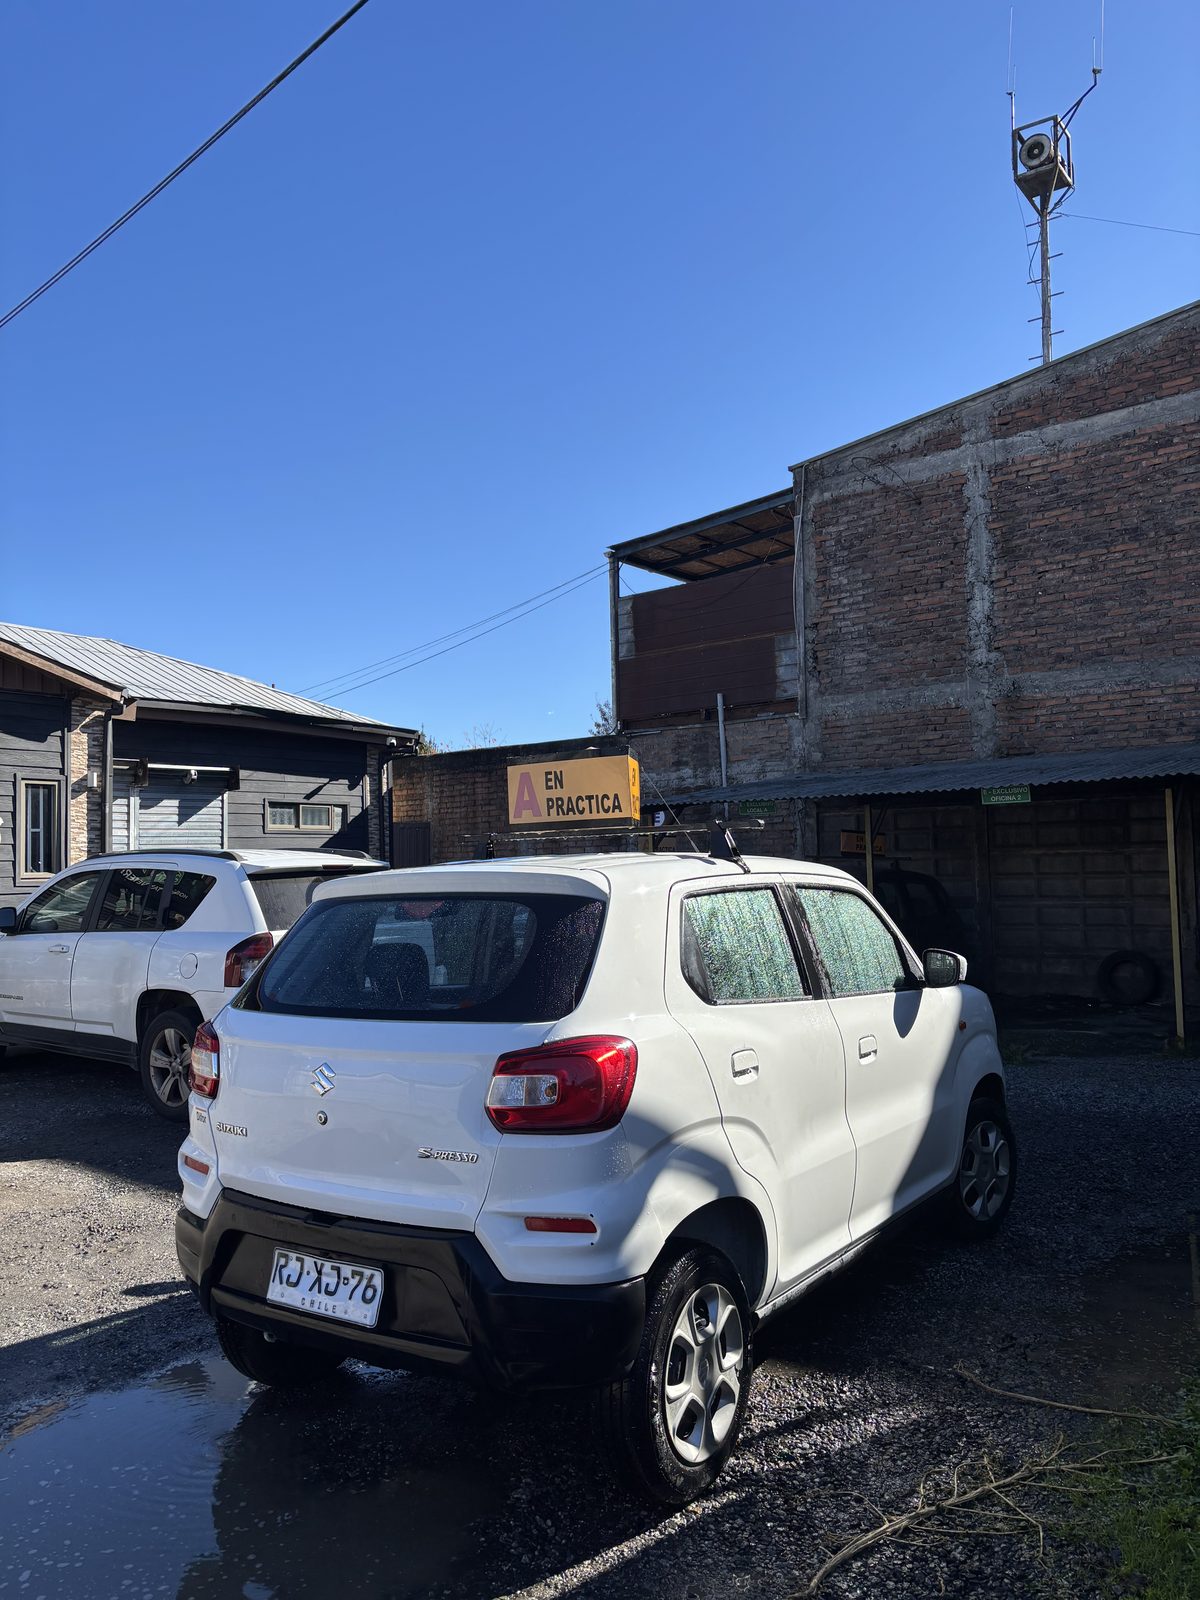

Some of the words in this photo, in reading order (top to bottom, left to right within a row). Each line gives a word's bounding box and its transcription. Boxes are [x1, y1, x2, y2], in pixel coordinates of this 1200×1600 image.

[545, 770, 563, 790] EN
[513, 772, 542, 818] A
[992, 787, 1028, 795] EXCLUSIVO
[547, 793, 622, 816] PRACTICA
[216, 1122, 248, 1137] SUZUKI
[301, 1297, 337, 1314] CHILE
